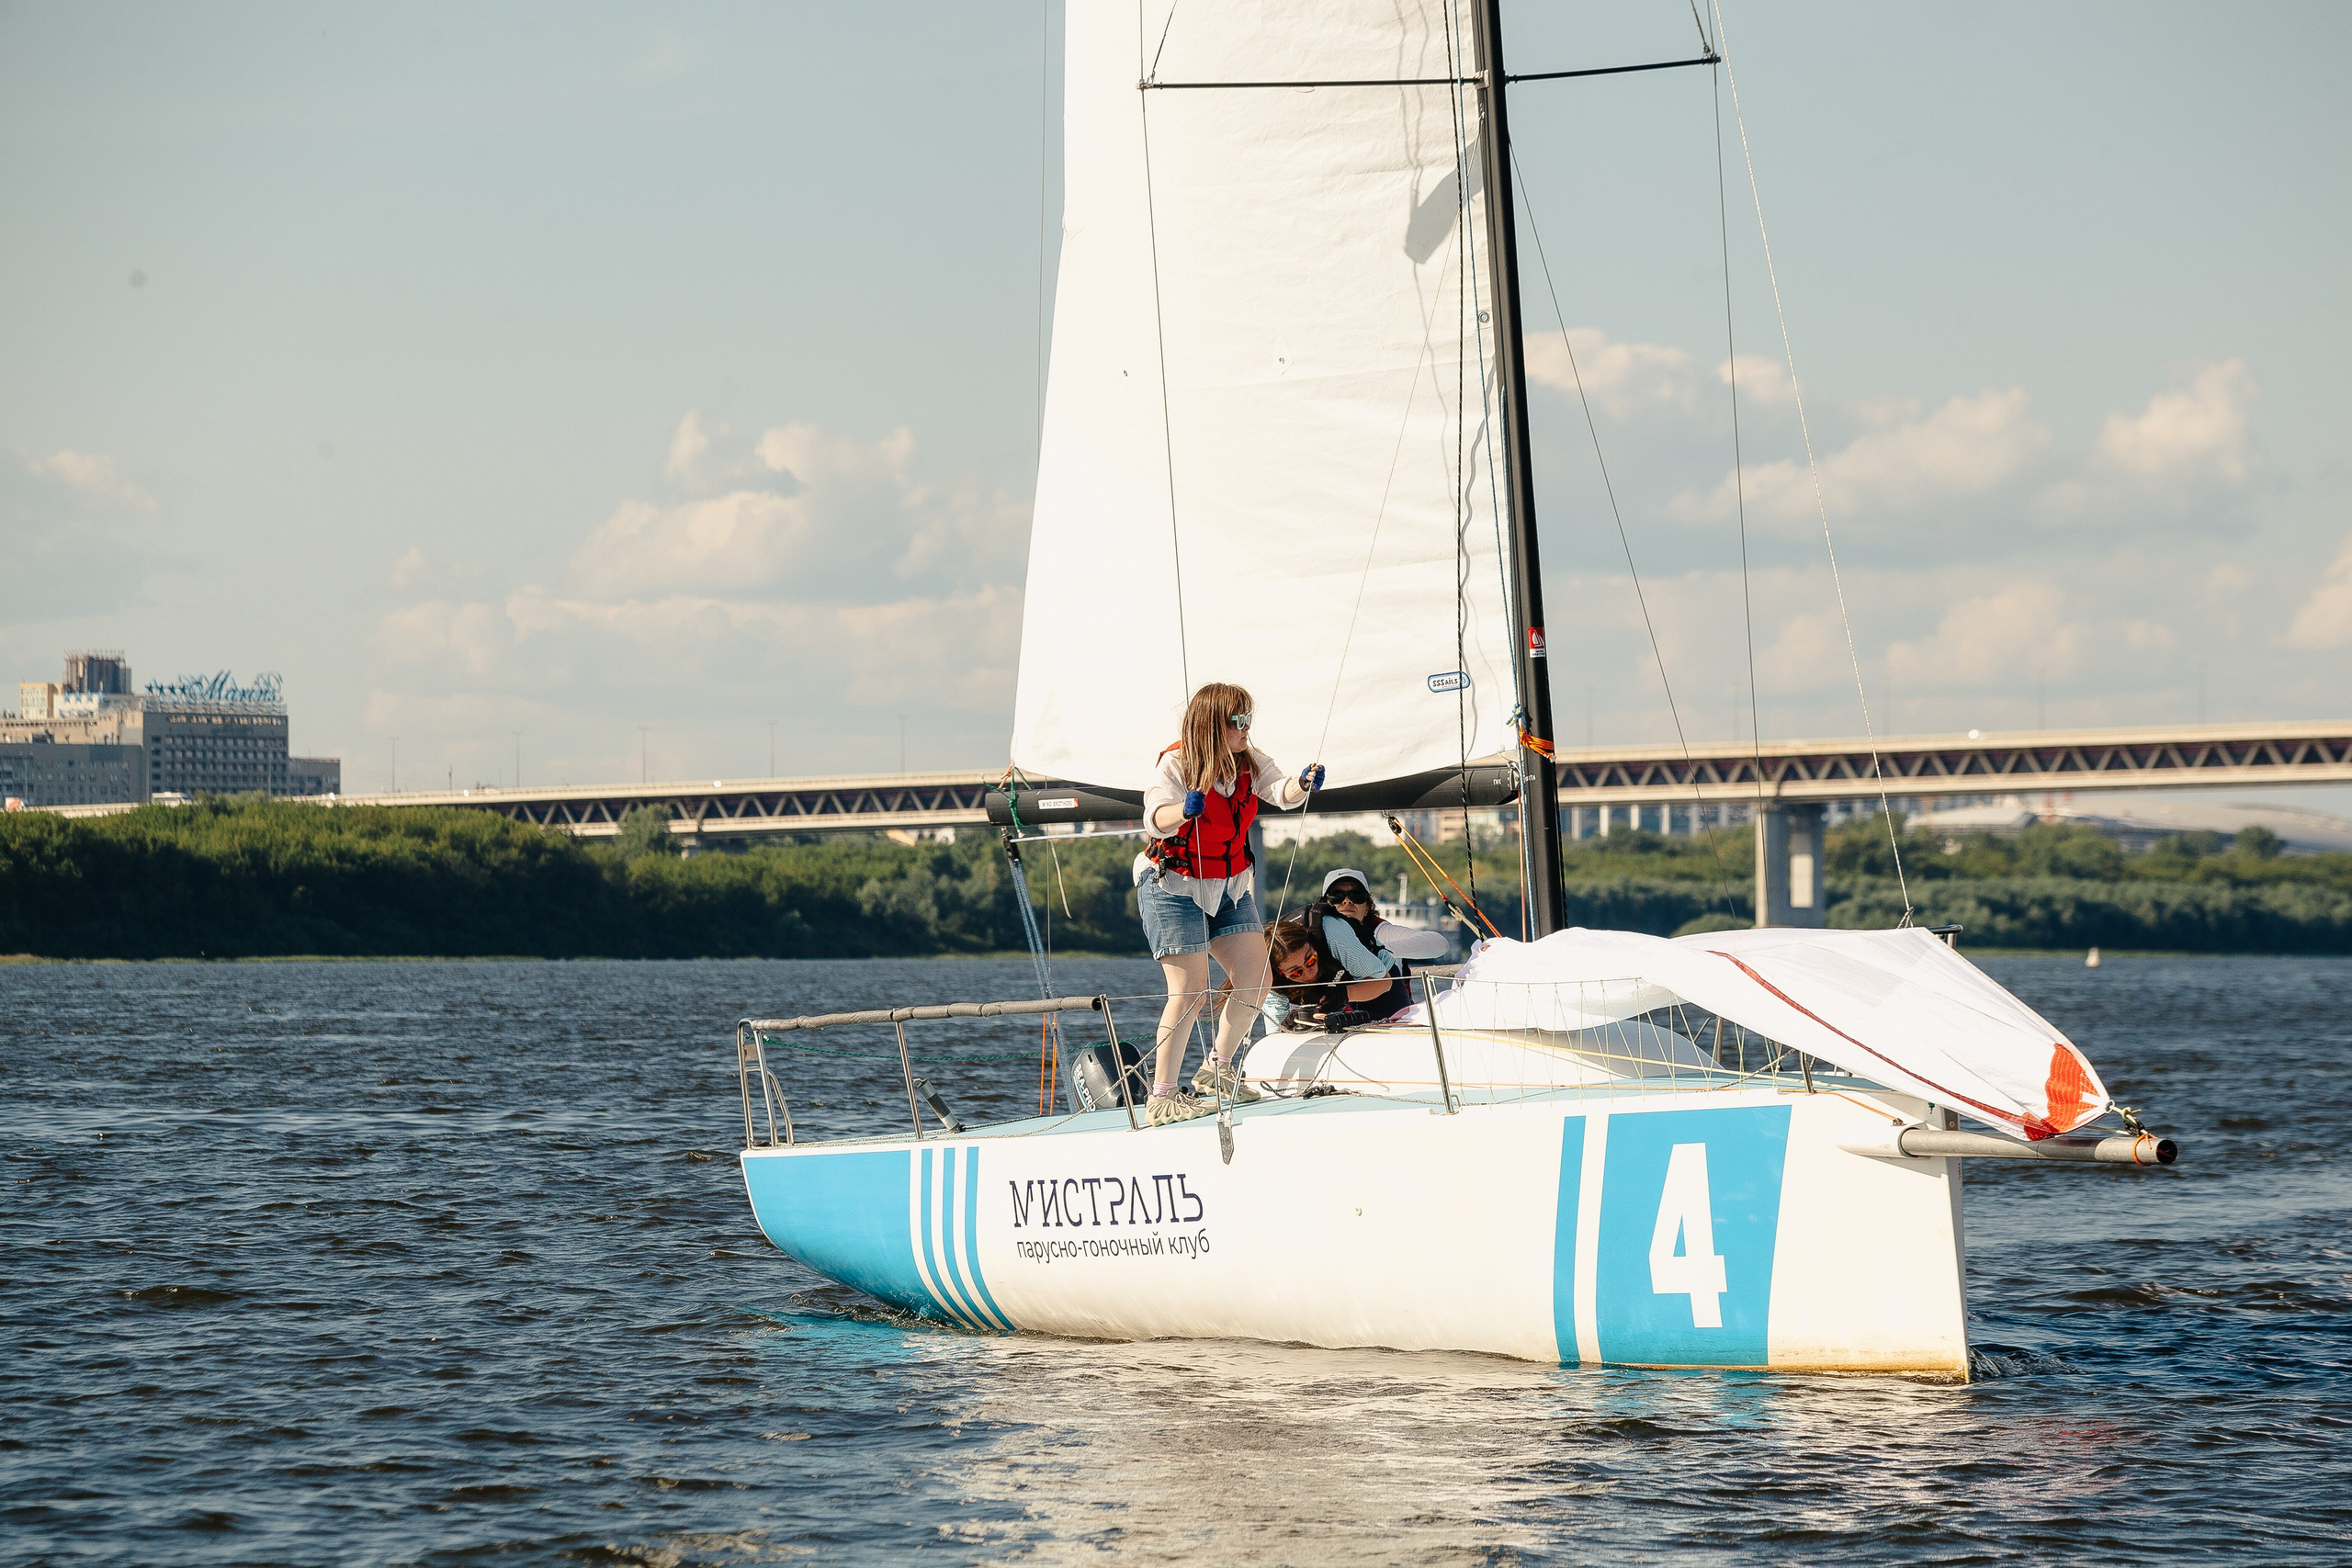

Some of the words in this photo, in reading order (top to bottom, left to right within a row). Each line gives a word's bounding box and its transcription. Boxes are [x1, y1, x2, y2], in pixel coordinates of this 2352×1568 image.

[1075, 1063, 1096, 1112] SEA-PRO
[1009, 1173, 1204, 1228] МИСТРАЛЬ
[1016, 1231, 1165, 1264] парусно-гоночный
[1168, 1228, 1211, 1260] клуб
[1648, 1142, 1728, 1328] 4
